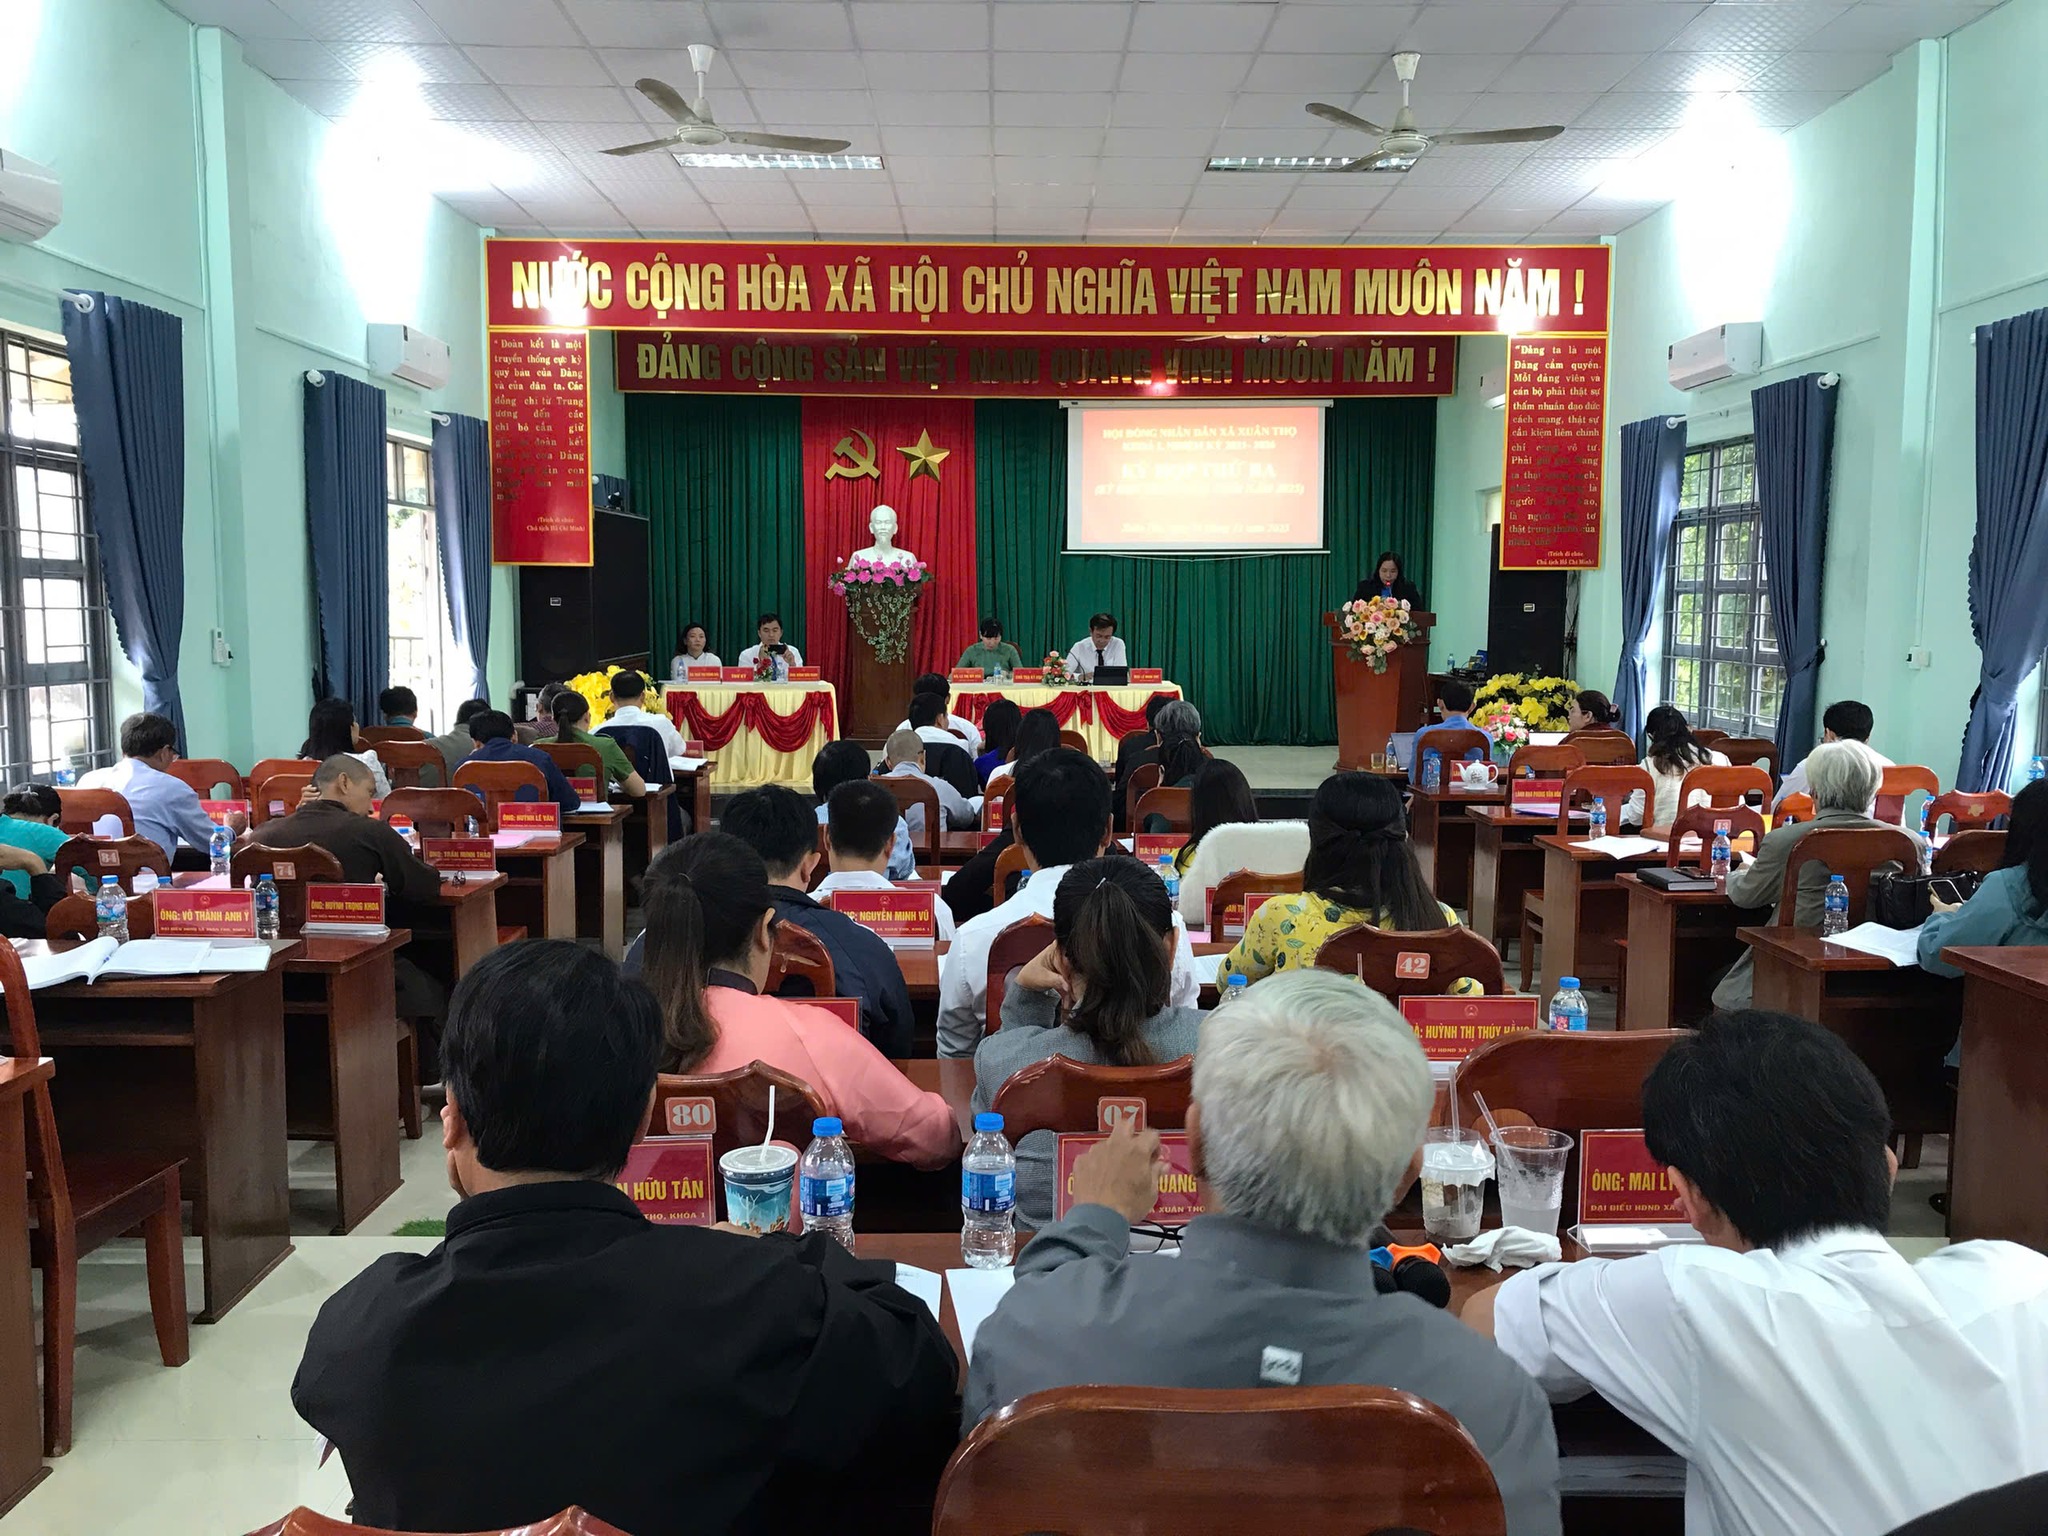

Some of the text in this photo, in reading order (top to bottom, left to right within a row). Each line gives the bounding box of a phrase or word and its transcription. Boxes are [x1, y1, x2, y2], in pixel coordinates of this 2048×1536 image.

[511, 250, 612, 309] NƯỚC
[626, 252, 725, 319] CỘNG
[738, 253, 808, 312] HÒA
[824, 257, 875, 312] XÃ
[889, 256, 948, 322] HỘI
[962, 250, 1033, 314] CHỦ
[1047, 259, 1158, 315] NGHĨA
[1168, 258, 1242, 323] VIỆT
[1256, 268, 1342, 315] NAM
[1354, 258, 1462, 315] MUÔN
[1475, 258, 1560, 315] NĂM
[551, 339, 560, 348] là
[565, 340, 581, 351] một
[1552, 346, 1561, 354] ta
[1569, 346, 1577, 354] là
[637, 331, 720, 379] ĐẢNG
[732, 338, 814, 388] CỘNG
[825, 335, 885, 381] SẢN
[897, 341, 960, 389] VIỆT
[969, 349, 1039, 383] NAM
[1051, 347, 1151, 388] QUANG
[1164, 348, 1232, 385] VINH
[1244, 340, 1333, 385] MUÔN
[1343, 341, 1414, 384] NĂM
[556, 396, 583, 407] Trung
[102, 852, 117, 863] 84
[276, 865, 293, 876] 74
[160, 908, 180, 920] ÔNG:
[194, 909, 222, 921] THÀNH
[224, 911, 242, 921] ANH
[860, 907, 892, 921] NGUYỄN
[895, 911, 916, 921] MINH
[918, 909, 929, 921] VŨ
[1399, 957, 1427, 974] 42
[1425, 1022, 1457, 1039] HUỲNH
[1460, 1025, 1474, 1041] THỊ
[1478, 1023, 1501, 1039] THÚY
[672, 1104, 711, 1126] 80
[1104, 1105, 1141, 1126] 07
[1592, 1168, 1624, 1191] ÔNG:
[1629, 1172, 1656, 1191] MAI
[633, 1177, 666, 1200] HỮU
[671, 1177, 704, 1199] TÂN
[669, 1211, 697, 1219] KHÓA
